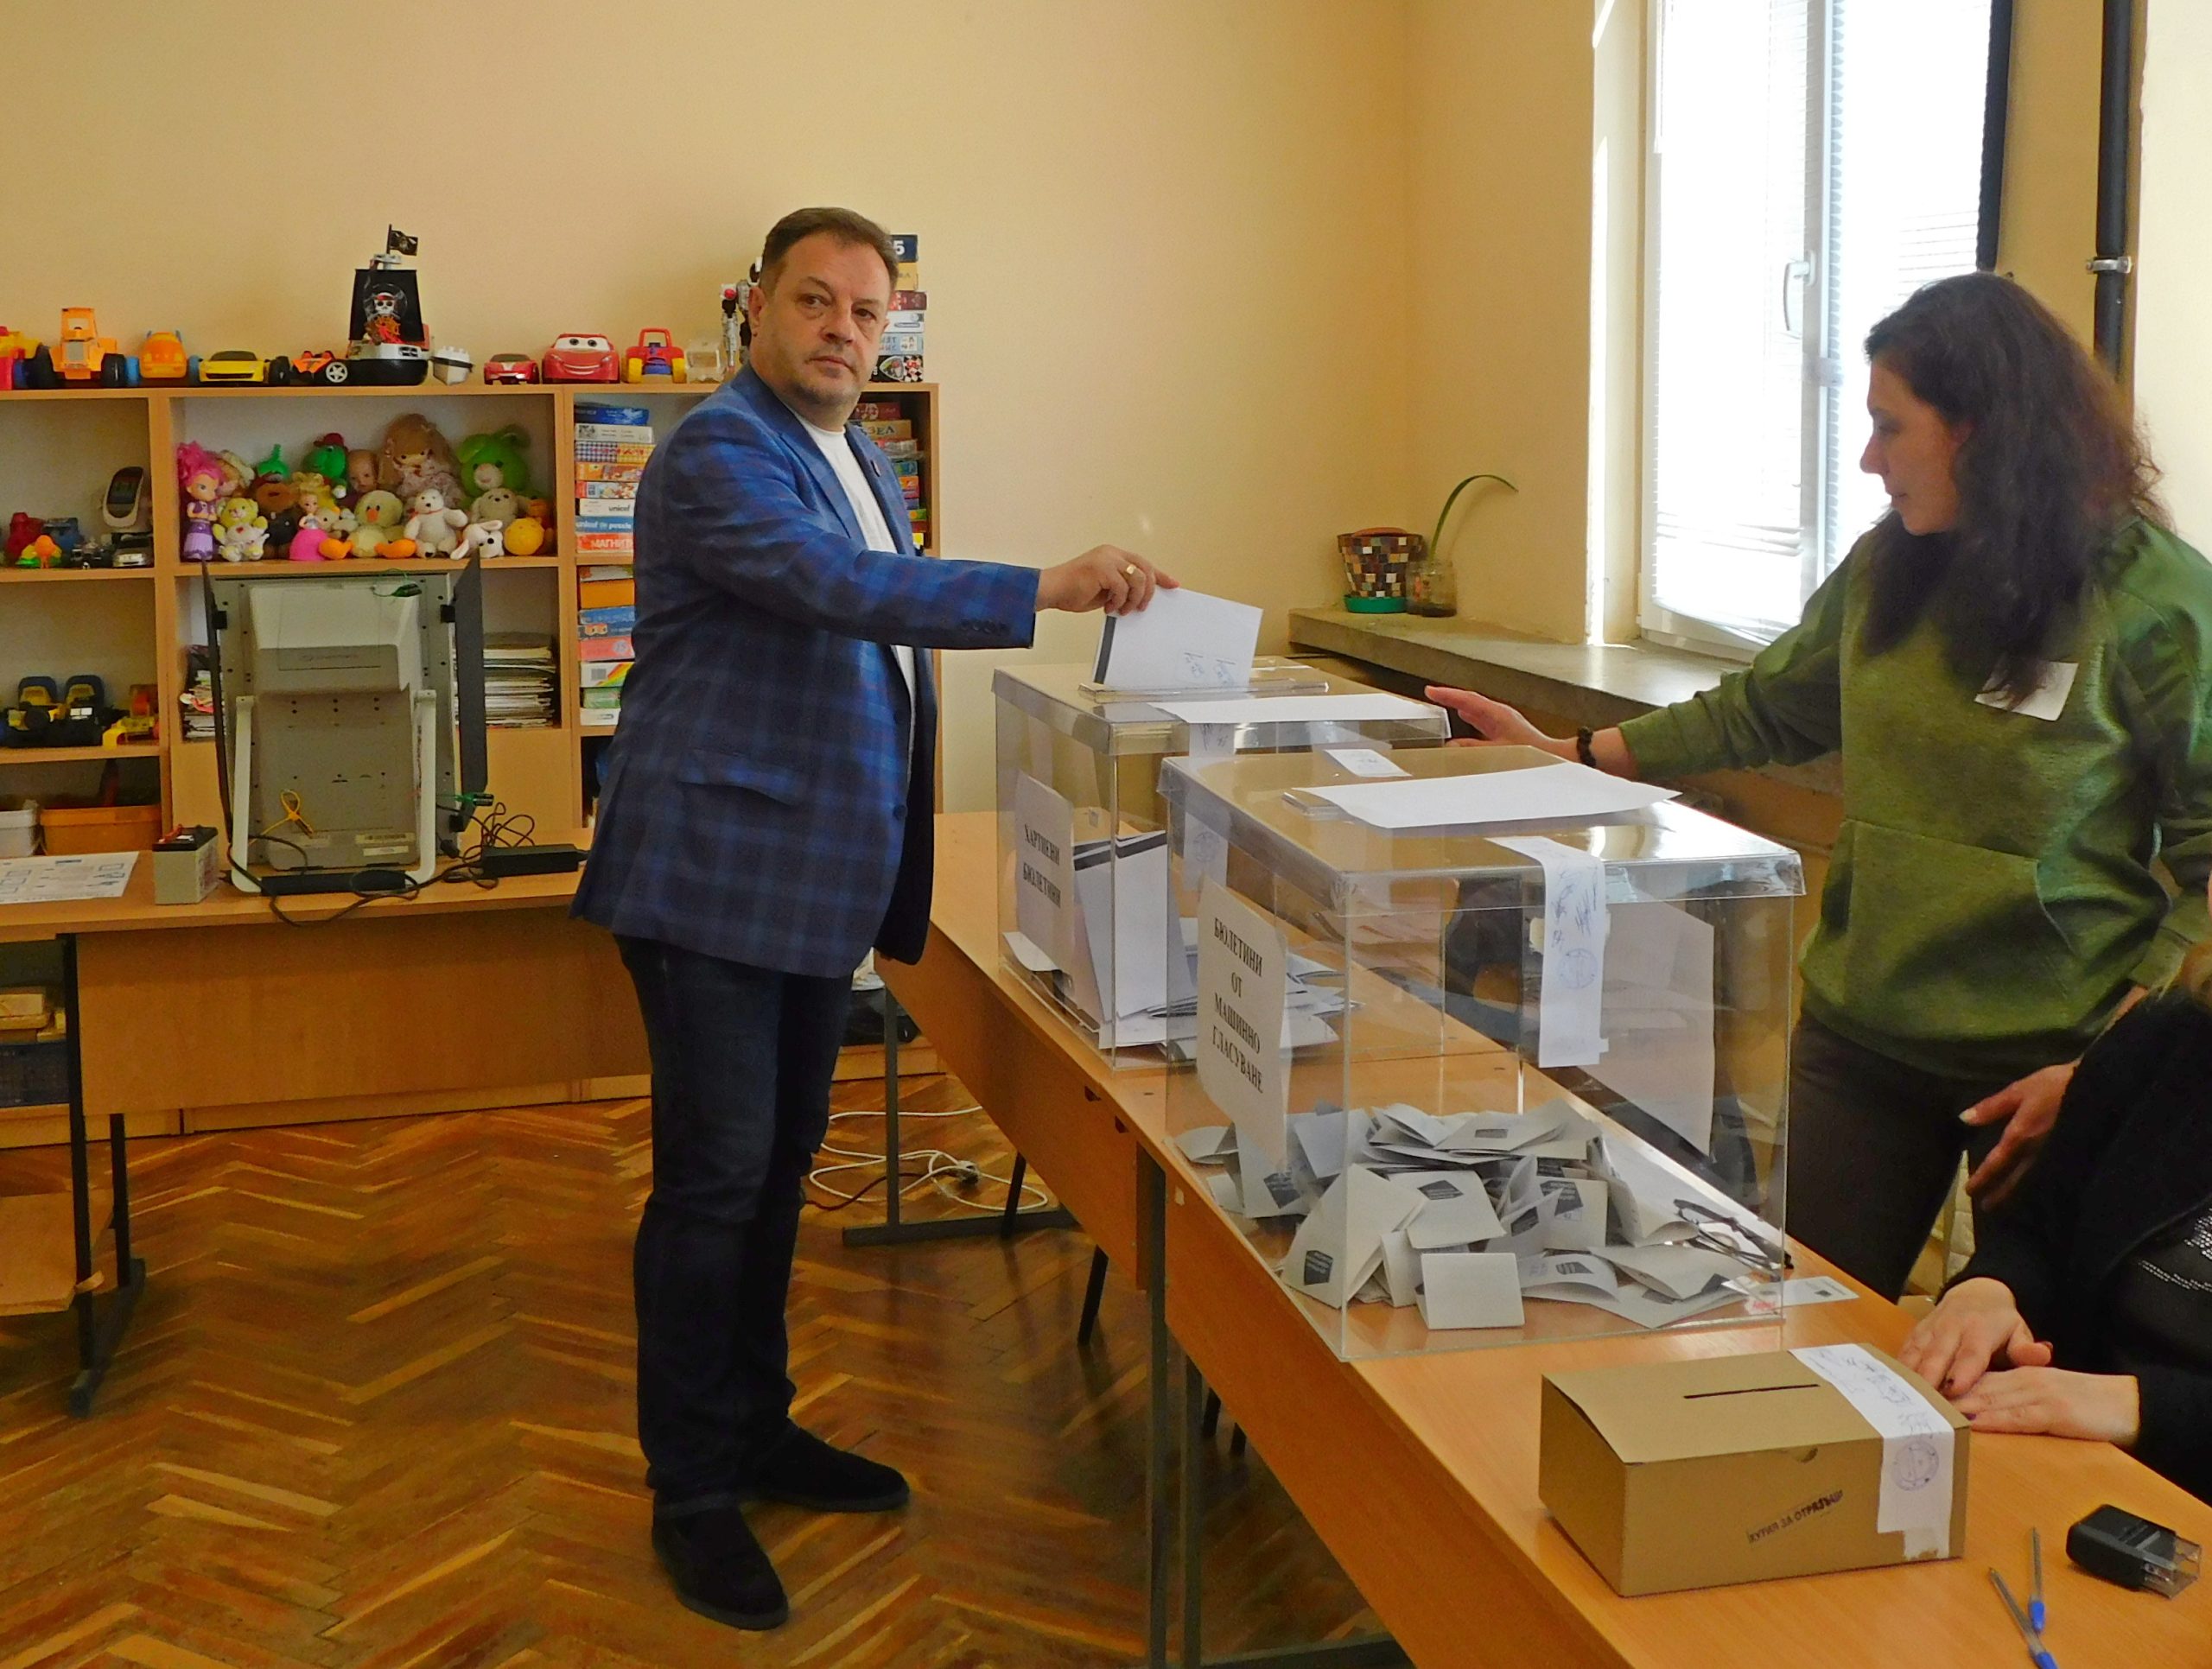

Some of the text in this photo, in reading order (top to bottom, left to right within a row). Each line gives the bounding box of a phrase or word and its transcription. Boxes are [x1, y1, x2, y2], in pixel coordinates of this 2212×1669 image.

[1024, 823, 1060, 866] ХАРТИЕНИ
[1023, 862, 1061, 908] БЮЛЕТИНИ
[1214, 917, 1262, 977] БЮЛЕТИНИ
[1231, 972, 1243, 998] ОТ
[1214, 993, 1260, 1054] МАШИННО
[1212, 1025, 1263, 1094] ГЛАСУВАНЕ
